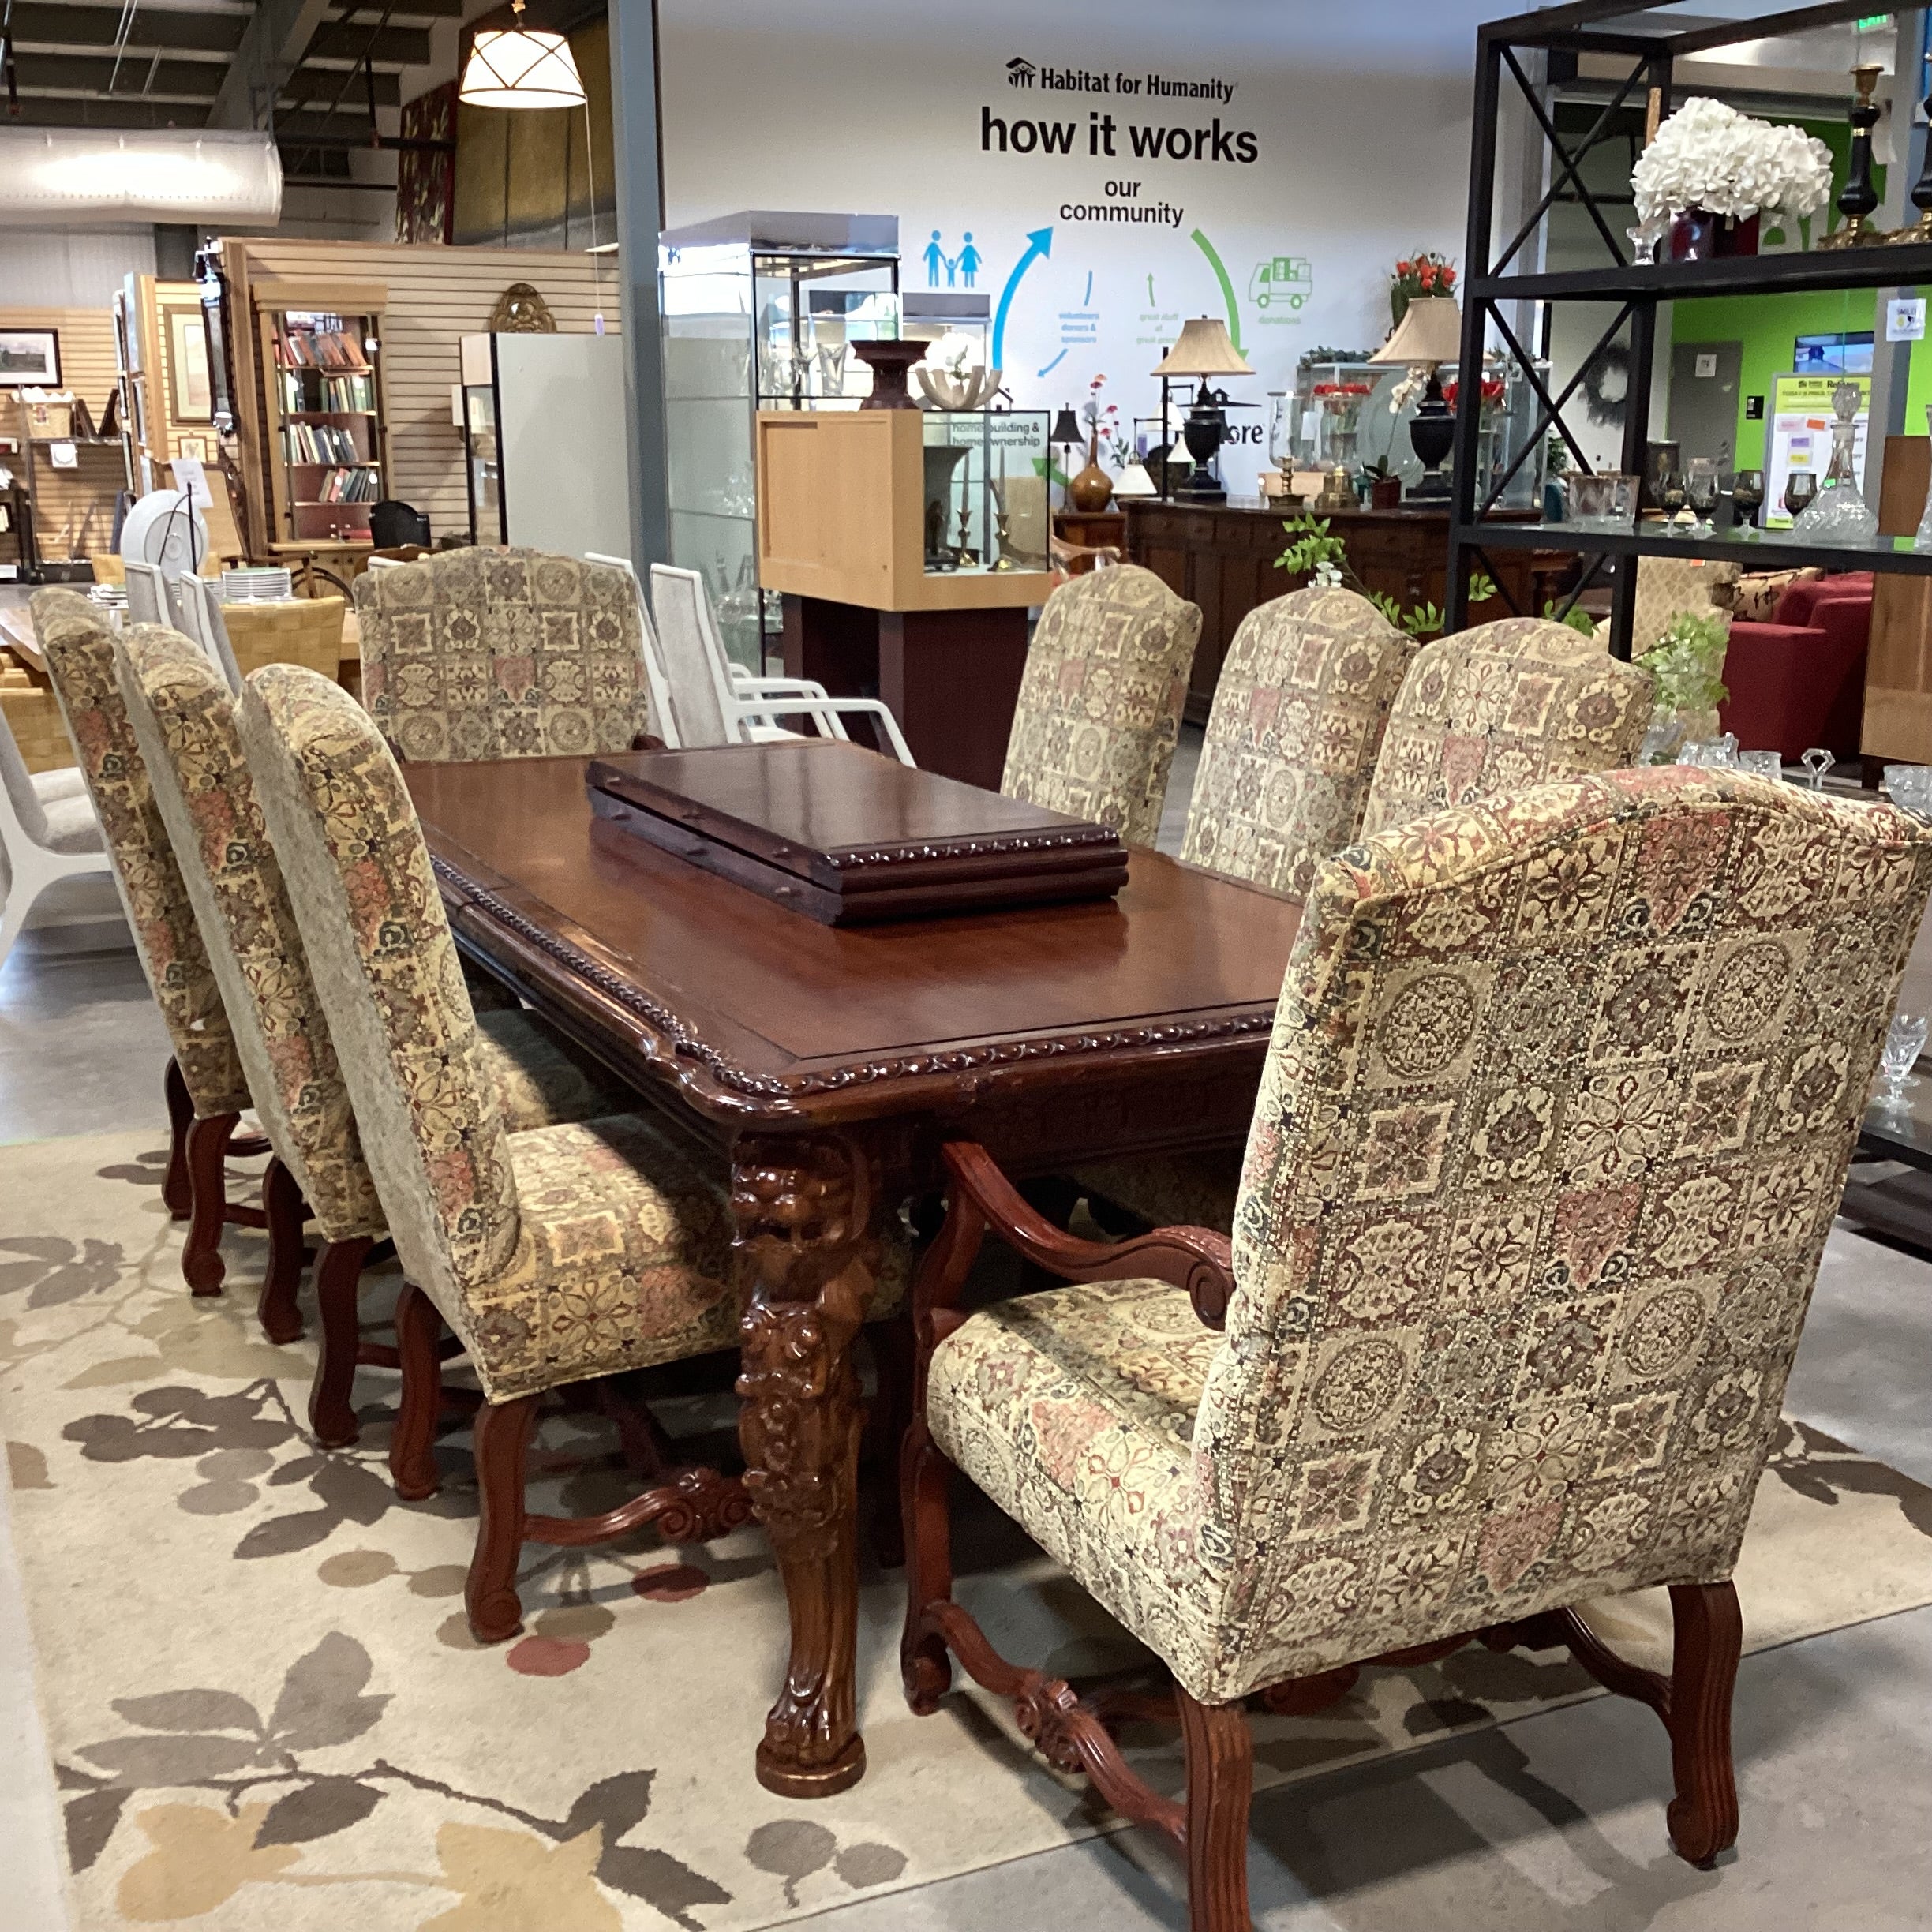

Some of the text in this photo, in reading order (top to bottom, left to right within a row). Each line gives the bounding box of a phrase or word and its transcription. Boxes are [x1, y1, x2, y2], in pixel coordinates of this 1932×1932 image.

[1040, 68, 1234, 105] Habitat for Humanity
[982, 106, 1258, 163] how it works
[1105, 180, 1141, 197] our
[1060, 202, 1184, 228] community
[1032, 422, 1040, 433] &
[953, 436, 1040, 447] homewnership
